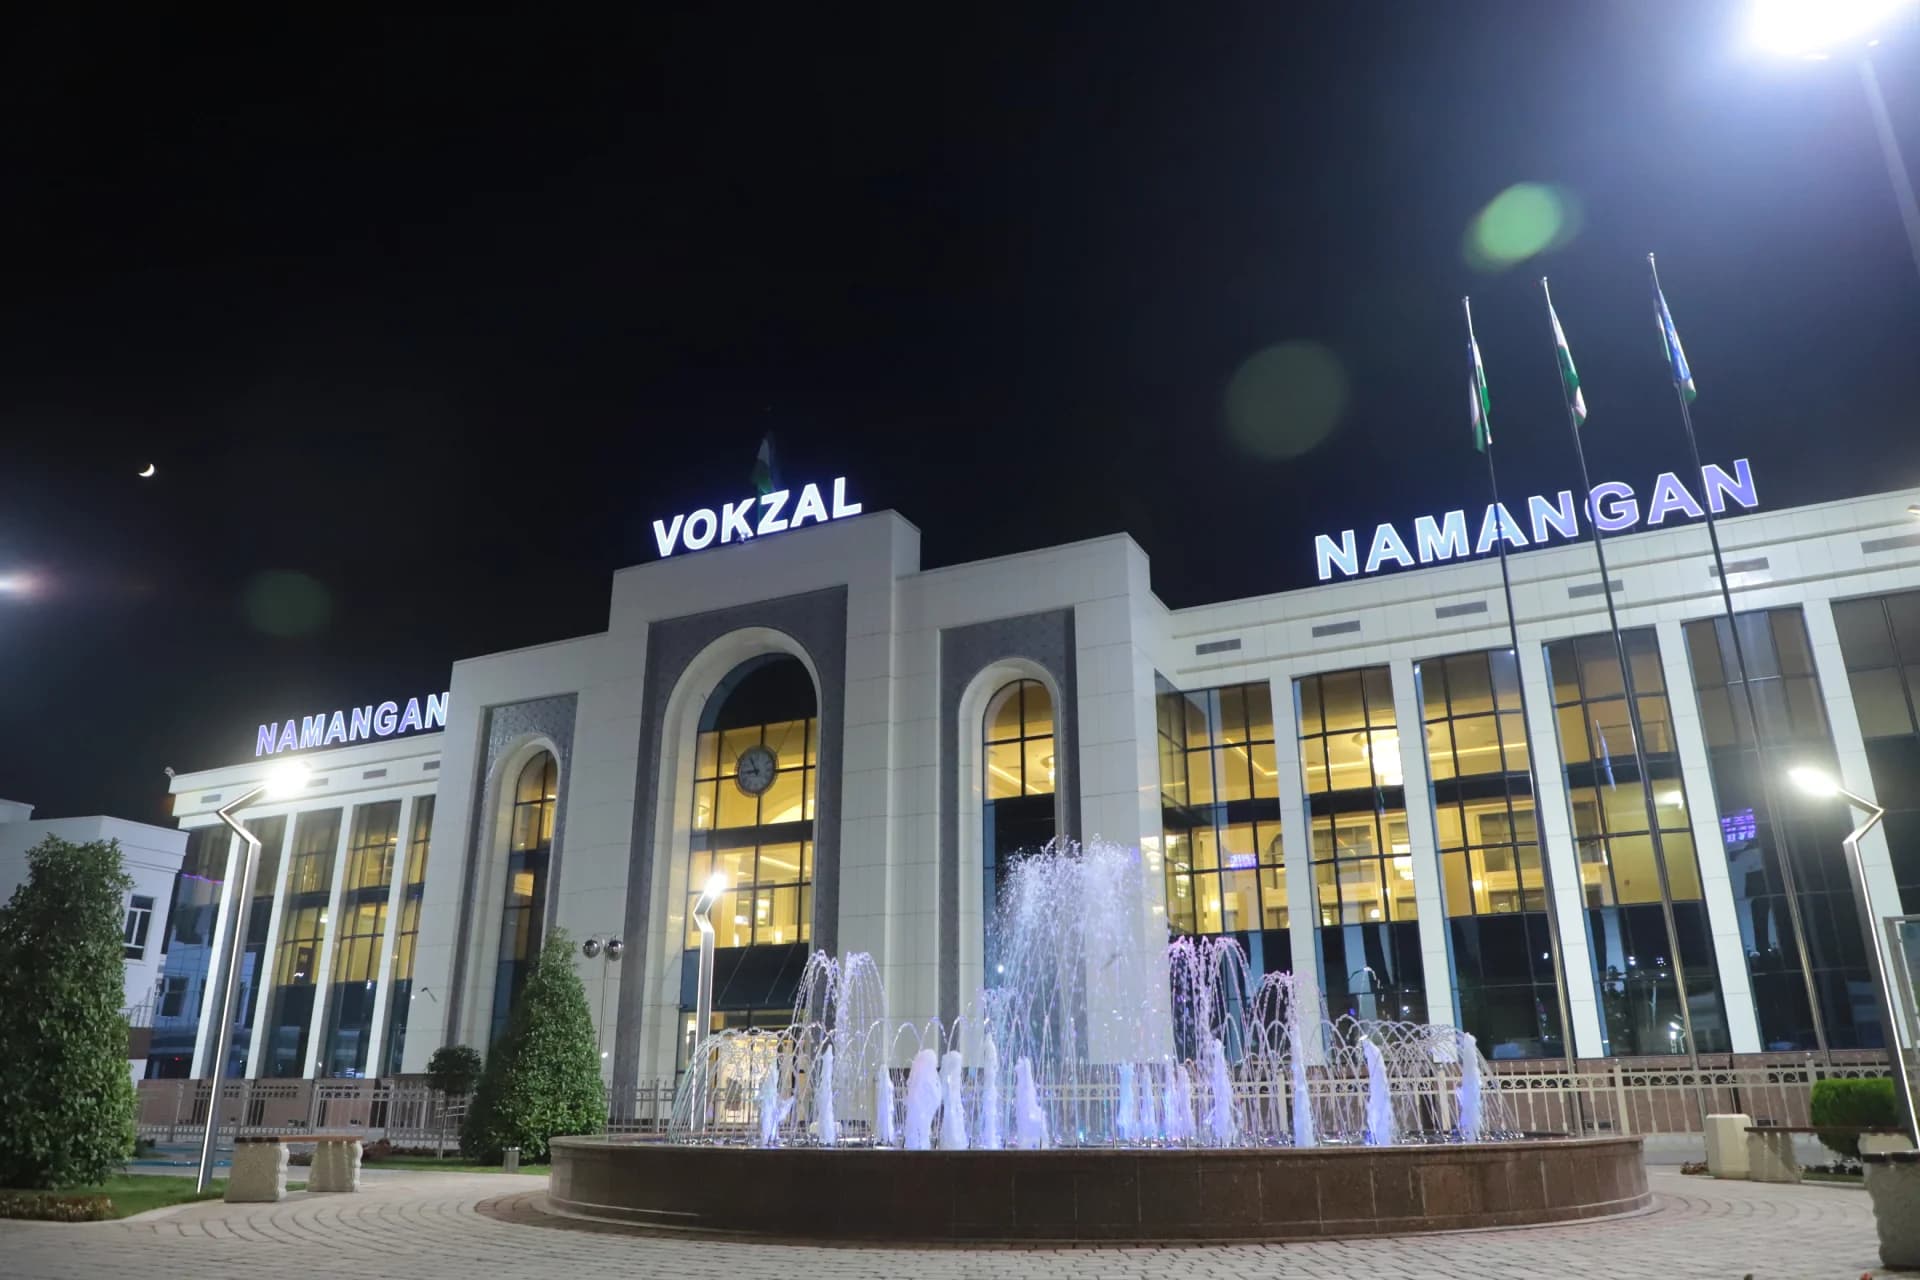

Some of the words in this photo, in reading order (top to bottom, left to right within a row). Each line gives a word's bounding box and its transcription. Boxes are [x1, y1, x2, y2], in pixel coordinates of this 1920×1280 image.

[652, 476, 862, 557] VOKZAL
[1314, 458, 1759, 580] NAMANGAN
[255, 691, 450, 756] NAMANGAN
